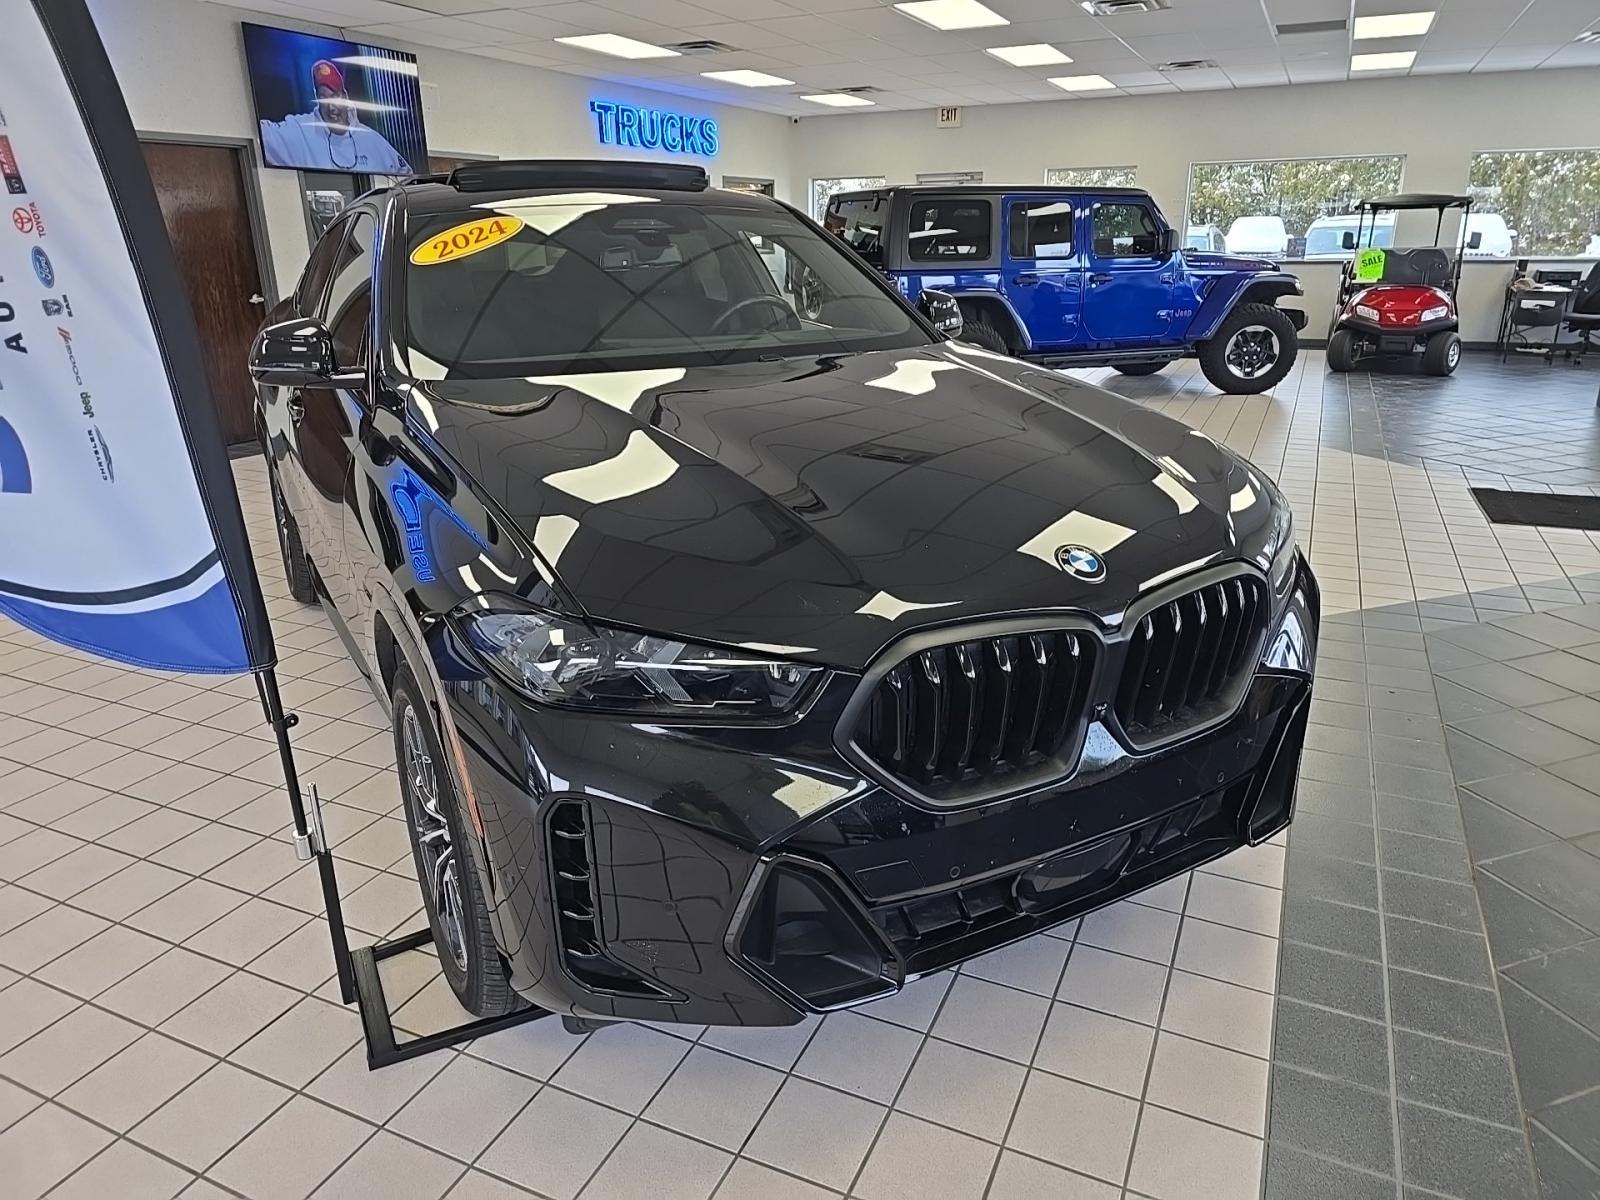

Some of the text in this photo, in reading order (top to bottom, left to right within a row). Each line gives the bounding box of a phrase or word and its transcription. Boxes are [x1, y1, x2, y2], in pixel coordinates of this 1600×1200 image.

[590, 101, 719, 156] TRUCKS
[941, 107, 958, 122] EXIT
[29, 201, 46, 238] TOYOTA
[433, 220, 507, 258] 2024
[1361, 254, 1383, 267] SALE
[62, 294, 73, 318] RAM
[80, 391, 94, 418] Jeep
[87, 429, 108, 481] CHRYSLER
